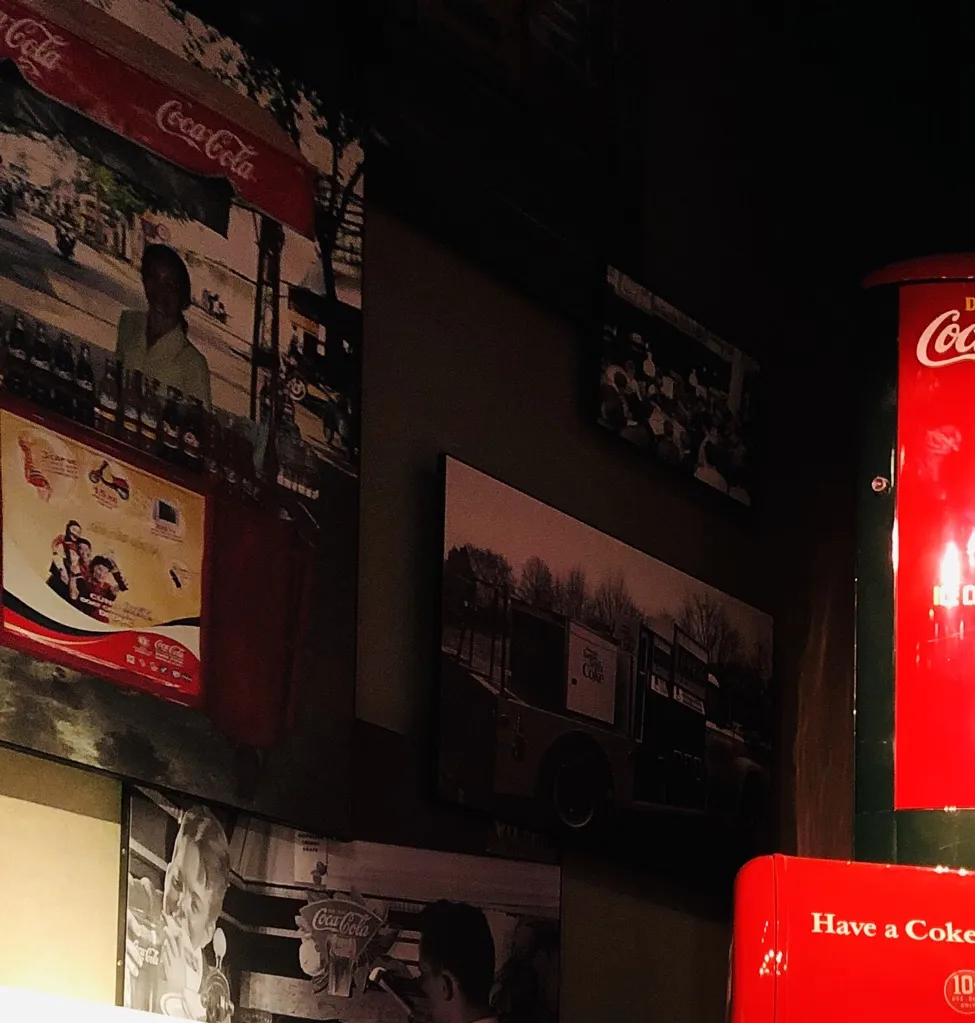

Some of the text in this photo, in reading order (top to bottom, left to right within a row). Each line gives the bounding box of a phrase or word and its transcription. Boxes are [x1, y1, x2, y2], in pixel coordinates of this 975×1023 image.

[311, 907, 373, 937] Coca-Cola
[811, 911, 877, 938] Have
[885, 922, 899, 939] a
